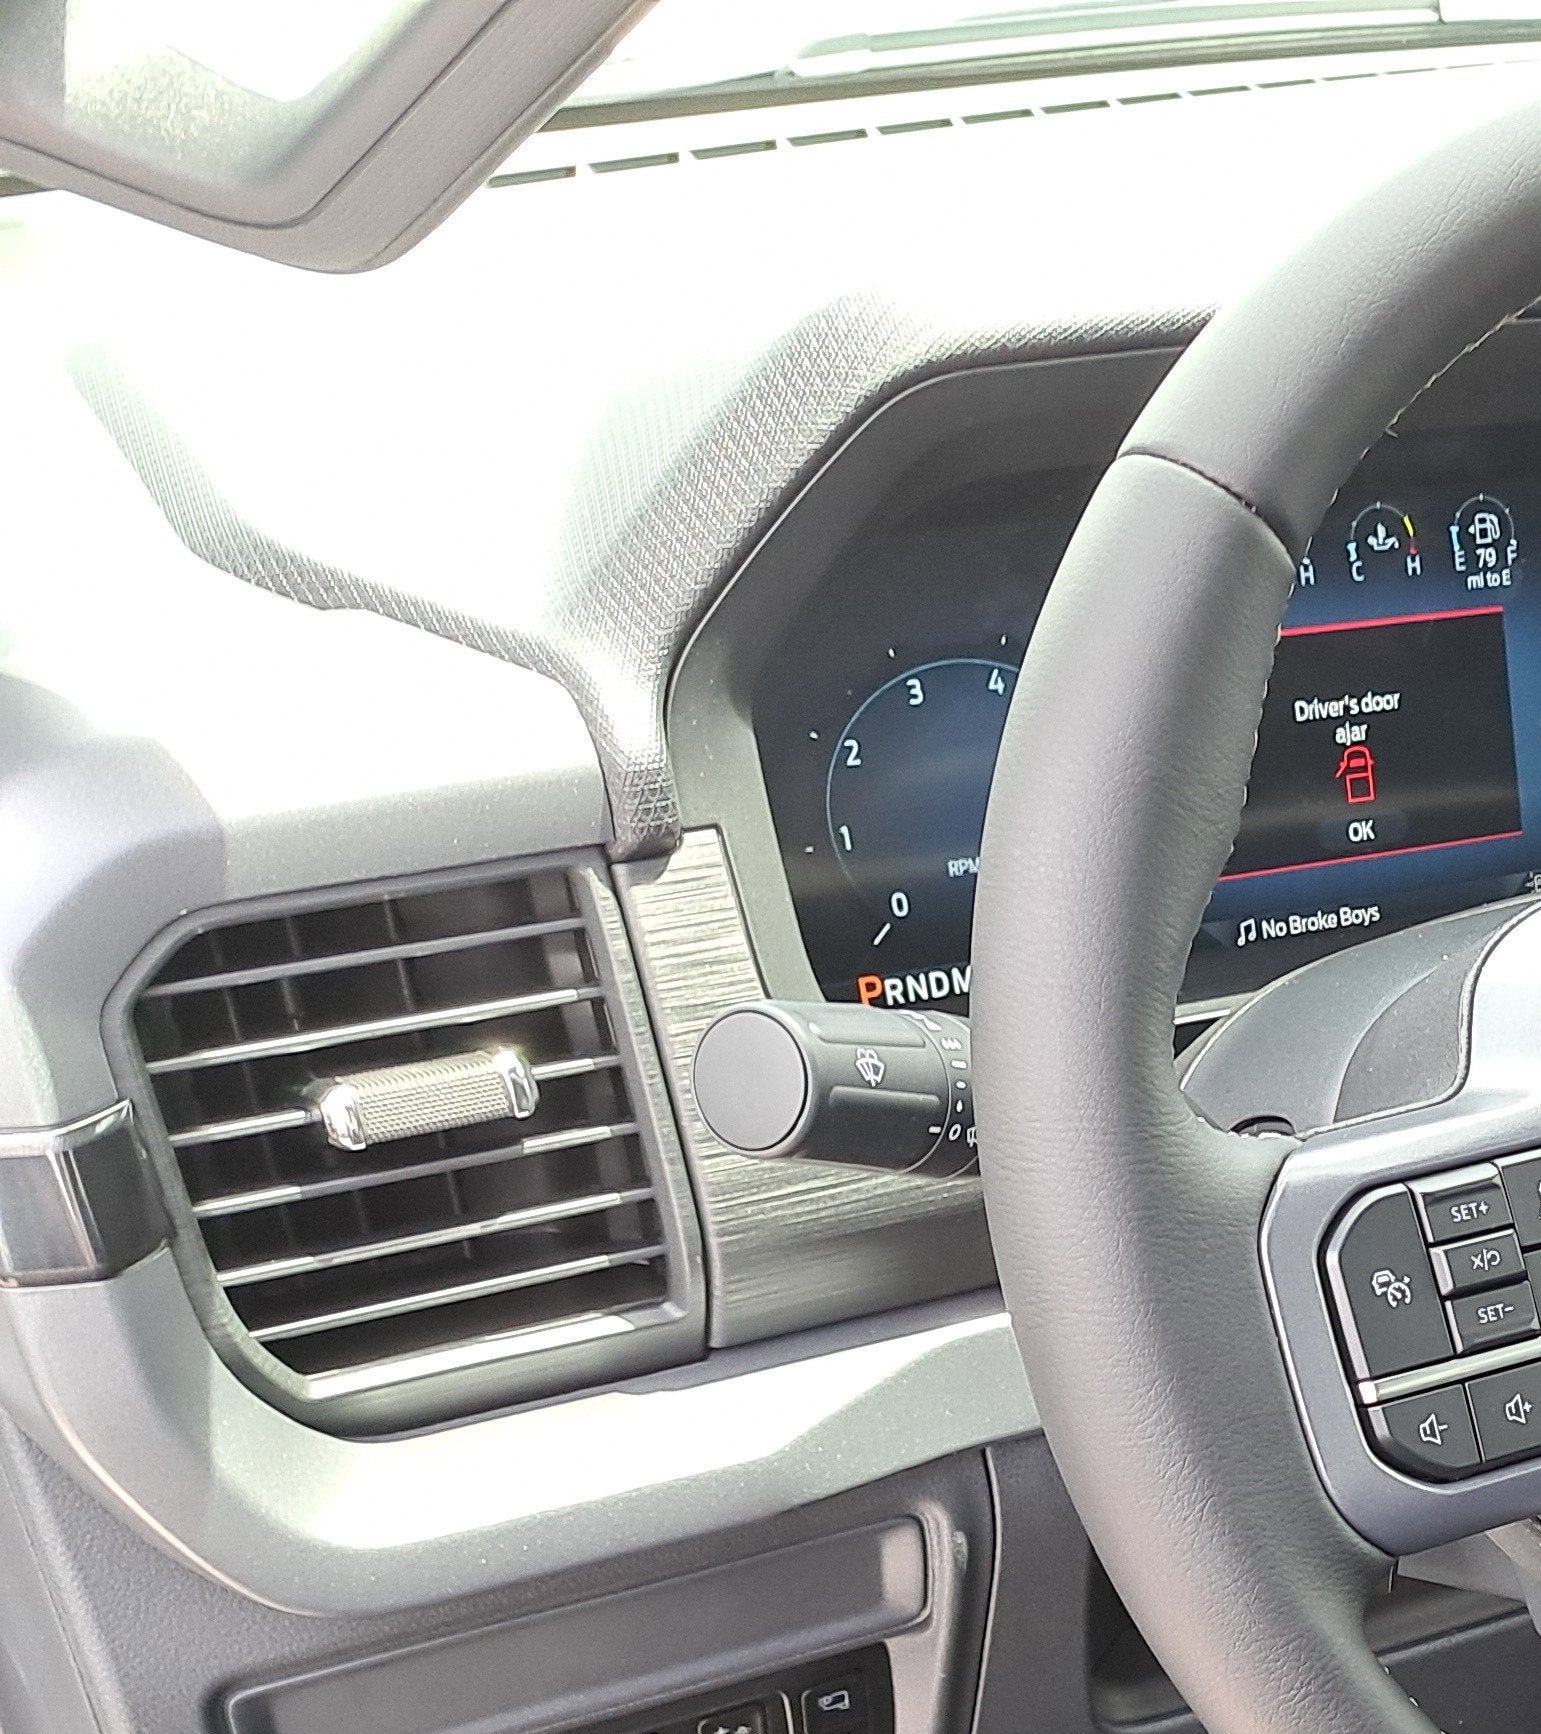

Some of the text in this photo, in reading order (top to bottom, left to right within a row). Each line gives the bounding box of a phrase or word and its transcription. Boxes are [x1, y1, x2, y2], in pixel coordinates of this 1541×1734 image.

[1352, 554, 1421, 582] C H
[1454, 550, 1466, 572] E
[1475, 549, 1496, 568] 79
[1299, 564, 1315, 587] H
[1486, 571, 1501, 587] to
[1502, 568, 1512, 585] E
[907, 668, 1006, 706] 3 4
[1294, 691, 1401, 722] Driver's door
[1335, 722, 1368, 746] ajar
[844, 739, 862, 767] 2
[839, 825, 852, 851] 1
[1348, 818, 1375, 842] OK
[891, 892, 908, 917] 0
[1261, 904, 1381, 939] No Broke Boys
[1450, 1202, 1490, 1223] SET+
